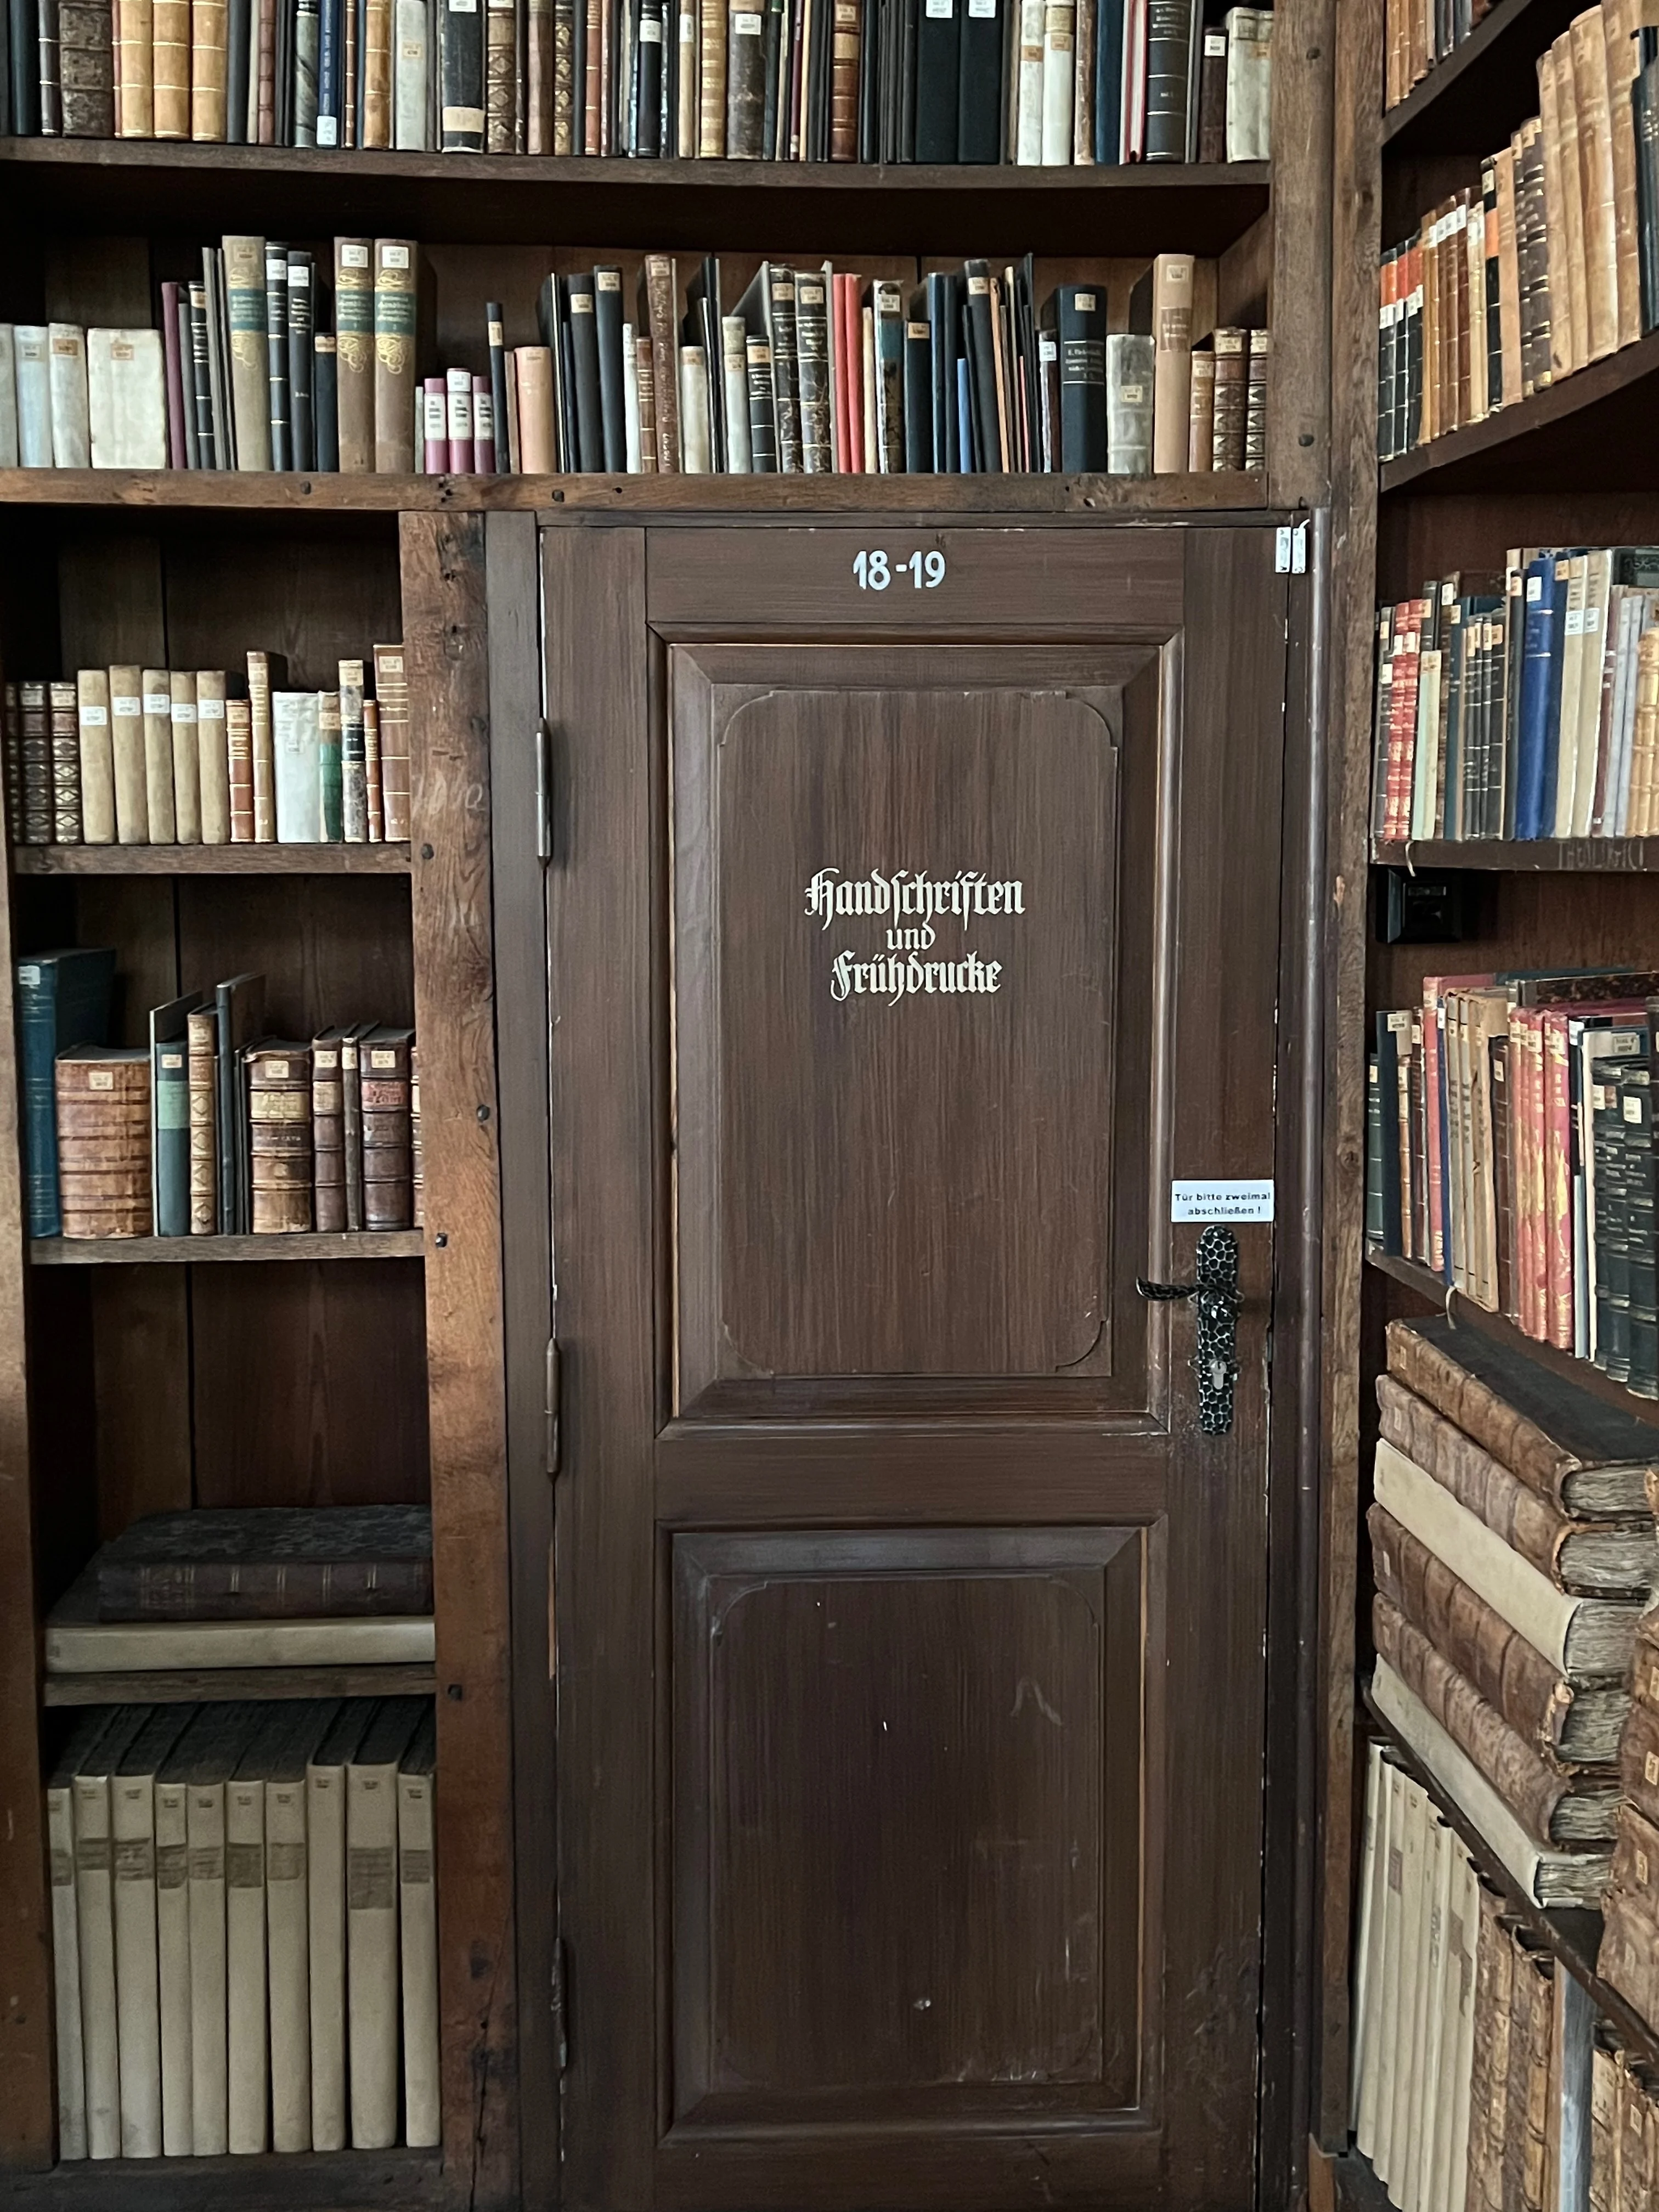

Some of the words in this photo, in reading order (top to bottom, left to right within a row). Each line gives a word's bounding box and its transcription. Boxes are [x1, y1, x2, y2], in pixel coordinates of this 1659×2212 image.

[853, 550, 946, 591] 18-19
[804, 867, 1026, 930] Handschriften
[886, 922, 936, 950] und
[831, 950, 1003, 1007] Frühdrucke
[1188, 1206, 1254, 1215] abschließen
[1225, 1192, 1271, 1200] zweimal
